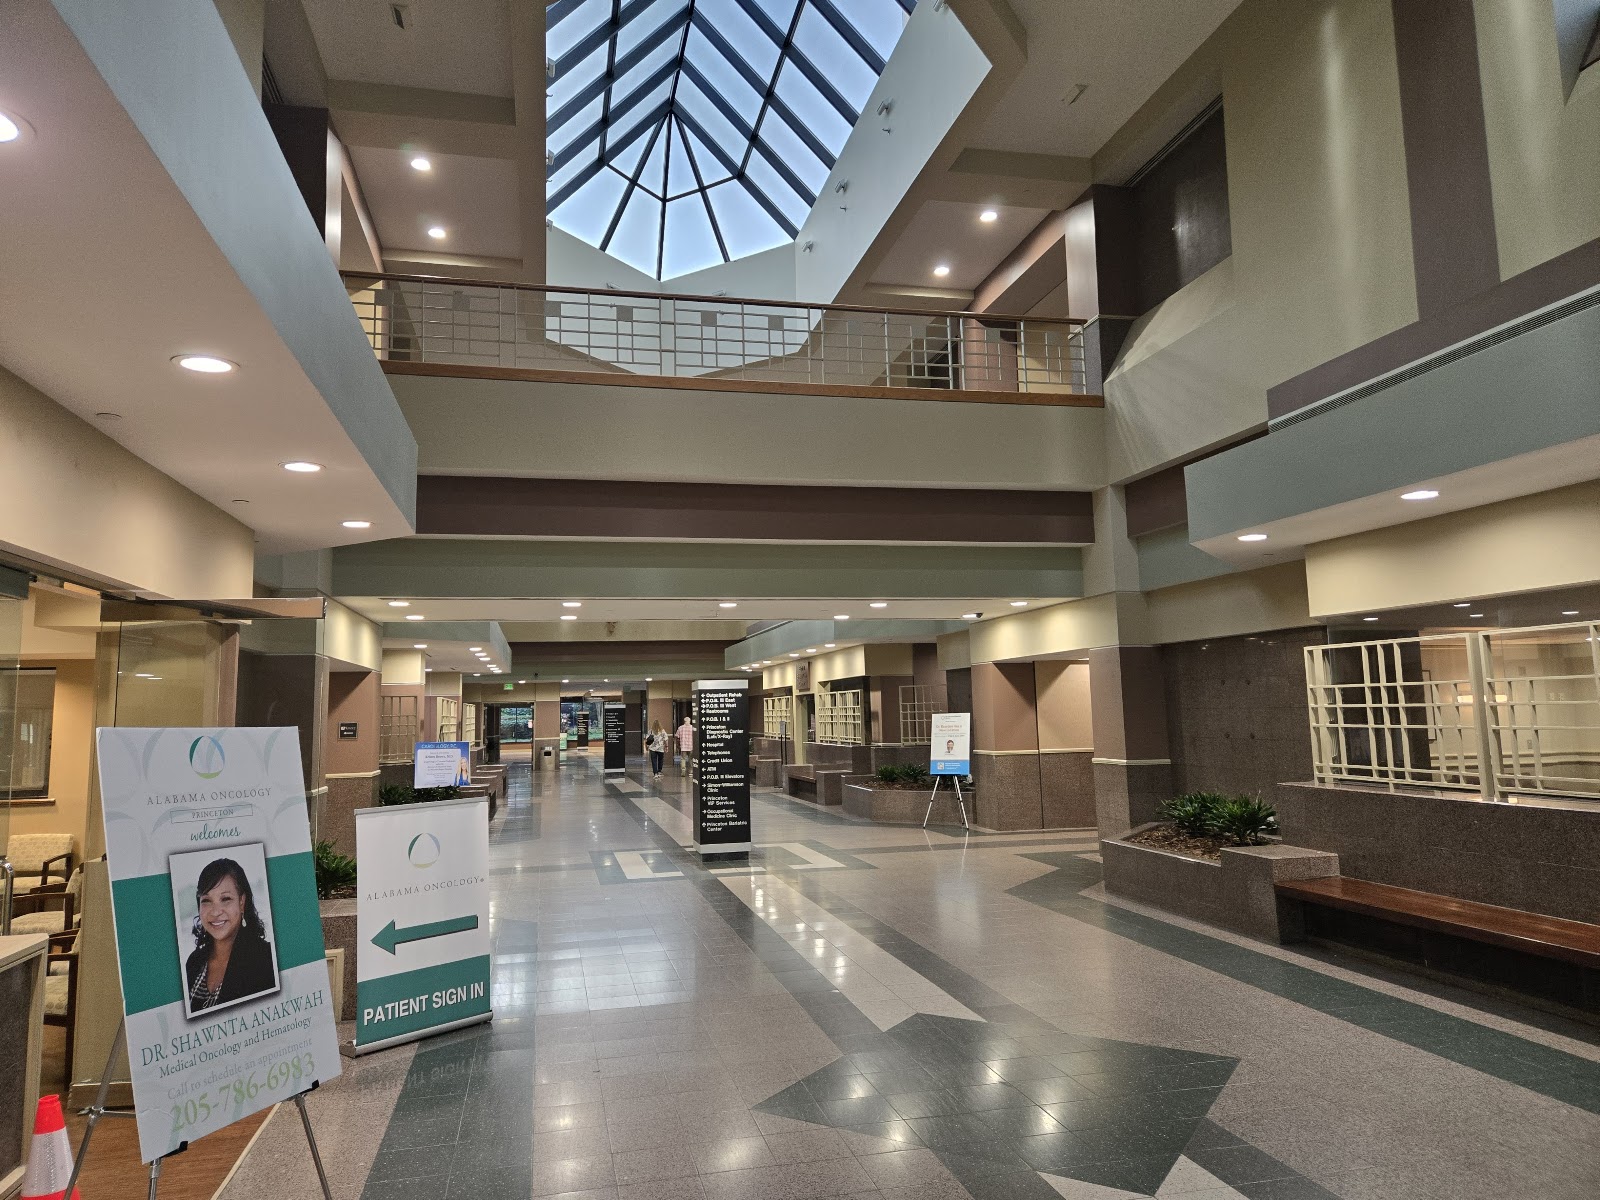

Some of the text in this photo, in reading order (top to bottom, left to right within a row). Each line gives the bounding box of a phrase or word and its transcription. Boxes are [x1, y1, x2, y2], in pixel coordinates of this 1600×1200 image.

[147, 788, 271, 806] ALABAMA ONCOLOGY
[192, 809, 234, 818] PRINCETON
[190, 823, 241, 841] welcomes
[366, 886, 420, 901] ALABAMA
[363, 982, 484, 1026] PATIENT SIGN IN
[142, 990, 324, 1066] DR. SHAWNTA ANAKWAH
[159, 1016, 312, 1078] Medical Oncology and Hematology
[168, 1038, 313, 1100] Call to schedule an appointment
[170, 1051, 316, 1132] 205-786-6983
